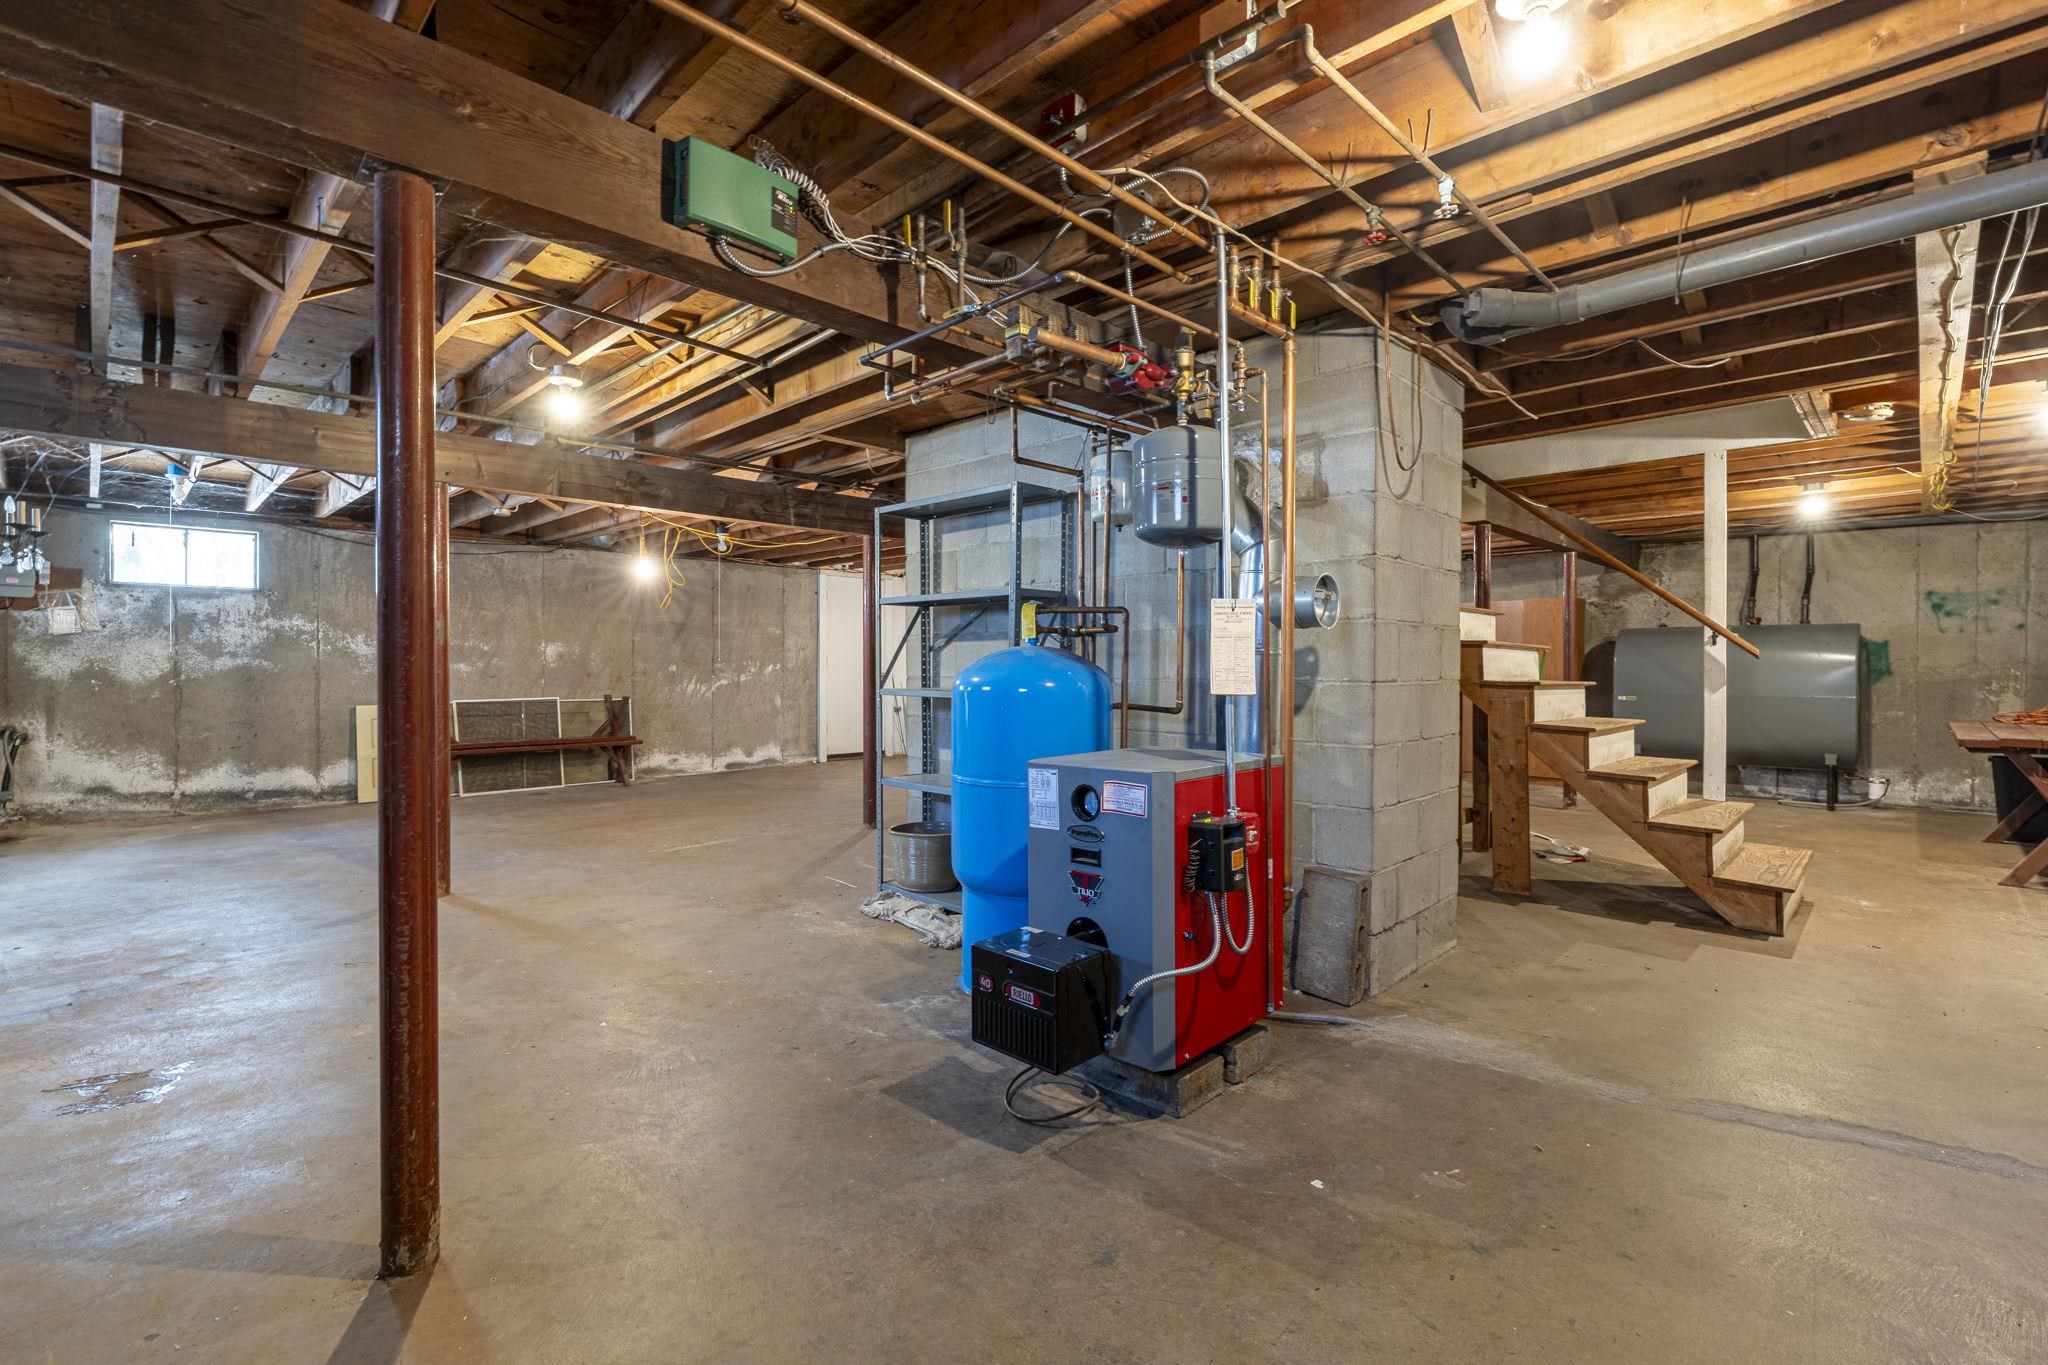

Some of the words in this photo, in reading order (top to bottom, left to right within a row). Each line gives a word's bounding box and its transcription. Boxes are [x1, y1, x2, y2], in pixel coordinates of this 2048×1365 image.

[775, 190, 793, 205] Taco
[1077, 886, 1095, 897] TRIO
[980, 977, 991, 988] 40
[1013, 988, 1033, 1003] RIELLO
